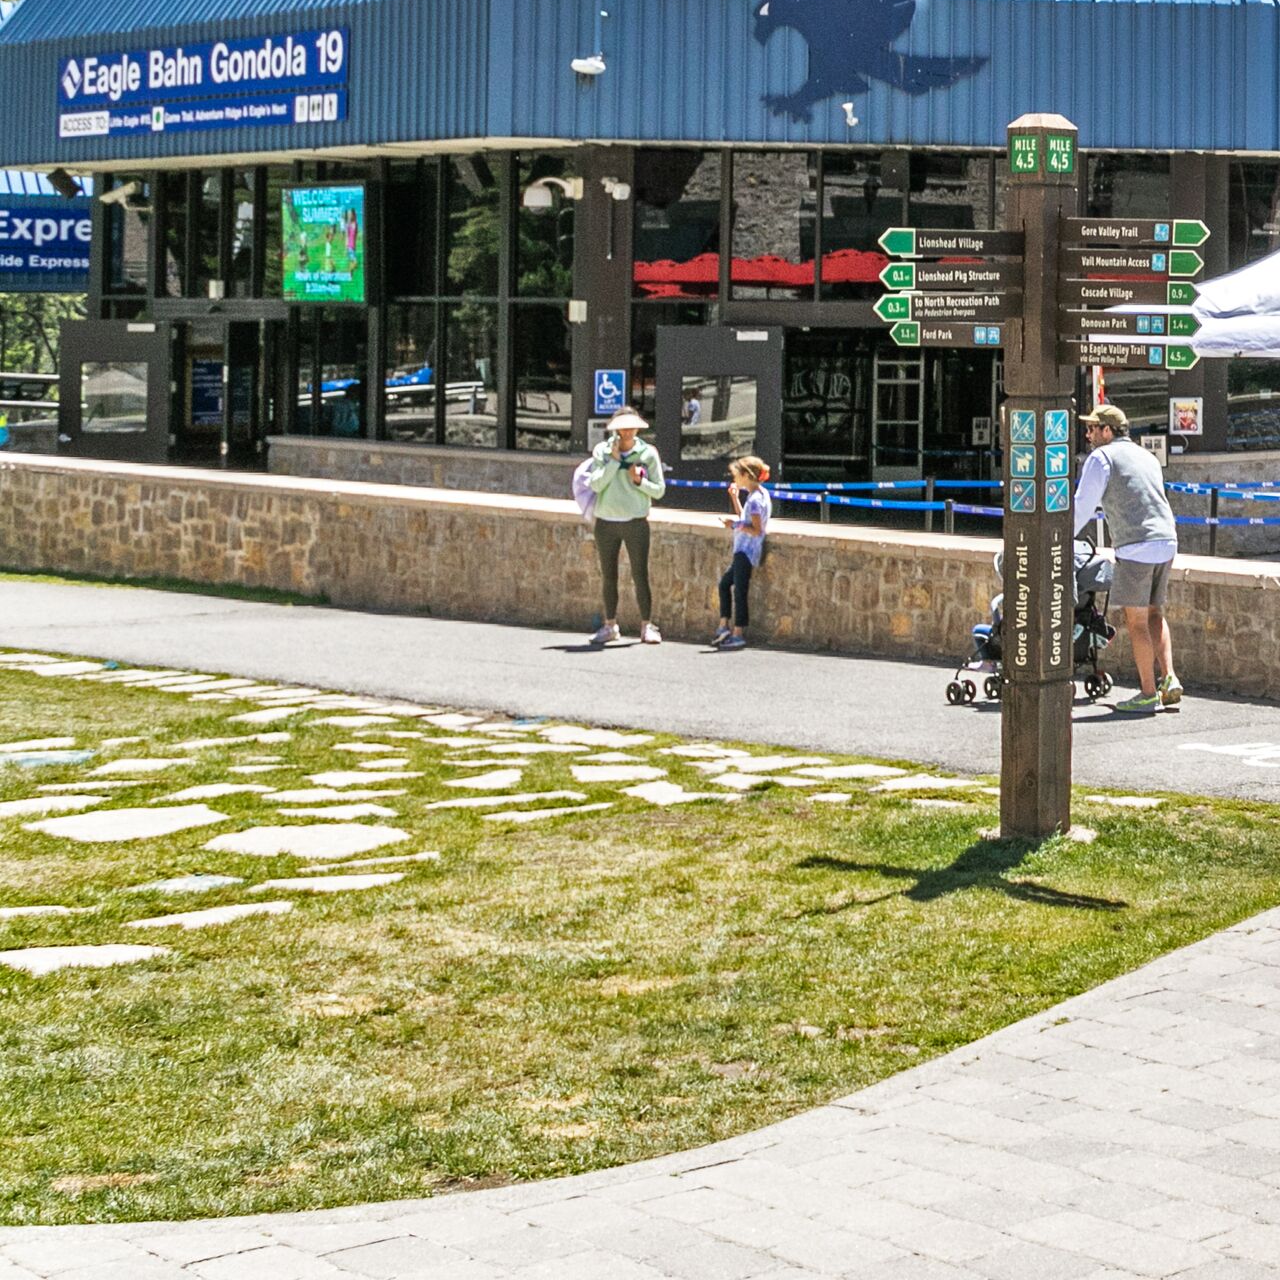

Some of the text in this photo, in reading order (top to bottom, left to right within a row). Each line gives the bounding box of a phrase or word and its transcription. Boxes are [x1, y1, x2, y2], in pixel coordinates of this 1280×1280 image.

[83, 30, 343, 101] Eagle Bahn Gondola 19
[195, 109, 224, 121] Adventure
[225, 107, 242, 120] Ridge
[63, 117, 92, 132] ACCESS
[123, 115, 139, 128] Eagle
[1015, 139, 1036, 151] MILE
[1050, 139, 1071, 152] MILE
[1016, 153, 1034, 169] 4.5
[1051, 153, 1069, 169] 4.5
[292, 189, 337, 206] WELCOME
[1081, 226, 1138, 239] Gore Valley Trail
[919, 237, 984, 251] Lionshead Village
[28, 254, 90, 270] Express
[1081, 256, 1150, 268] Vail Mountain Access
[893, 270, 904, 281] 0.1
[918, 271, 1000, 283] Lionshead Pkg Structure
[1081, 287, 1133, 301] Cascade Village
[1172, 289, 1183, 299] 0.9
[888, 303, 899, 312] 0.3
[915, 296, 1000, 308] to North Recreation Path
[924, 308, 952, 317] Pedestrian
[953, 308, 975, 317] Overpass
[1081, 317, 1127, 328] Donovan Park
[1173, 320, 1183, 329] 1.4
[901, 329, 910, 338] 1.1
[922, 329, 952, 340] Ford Park
[1080, 345, 1146, 357] to Eagle Valley Trail
[1170, 352, 1181, 361] 4.5
[1101, 356, 1115, 364] Valley
[1015, 545, 1031, 666] Gore Valley Trail
[1050, 545, 1064, 666] Gore Valley Trail
